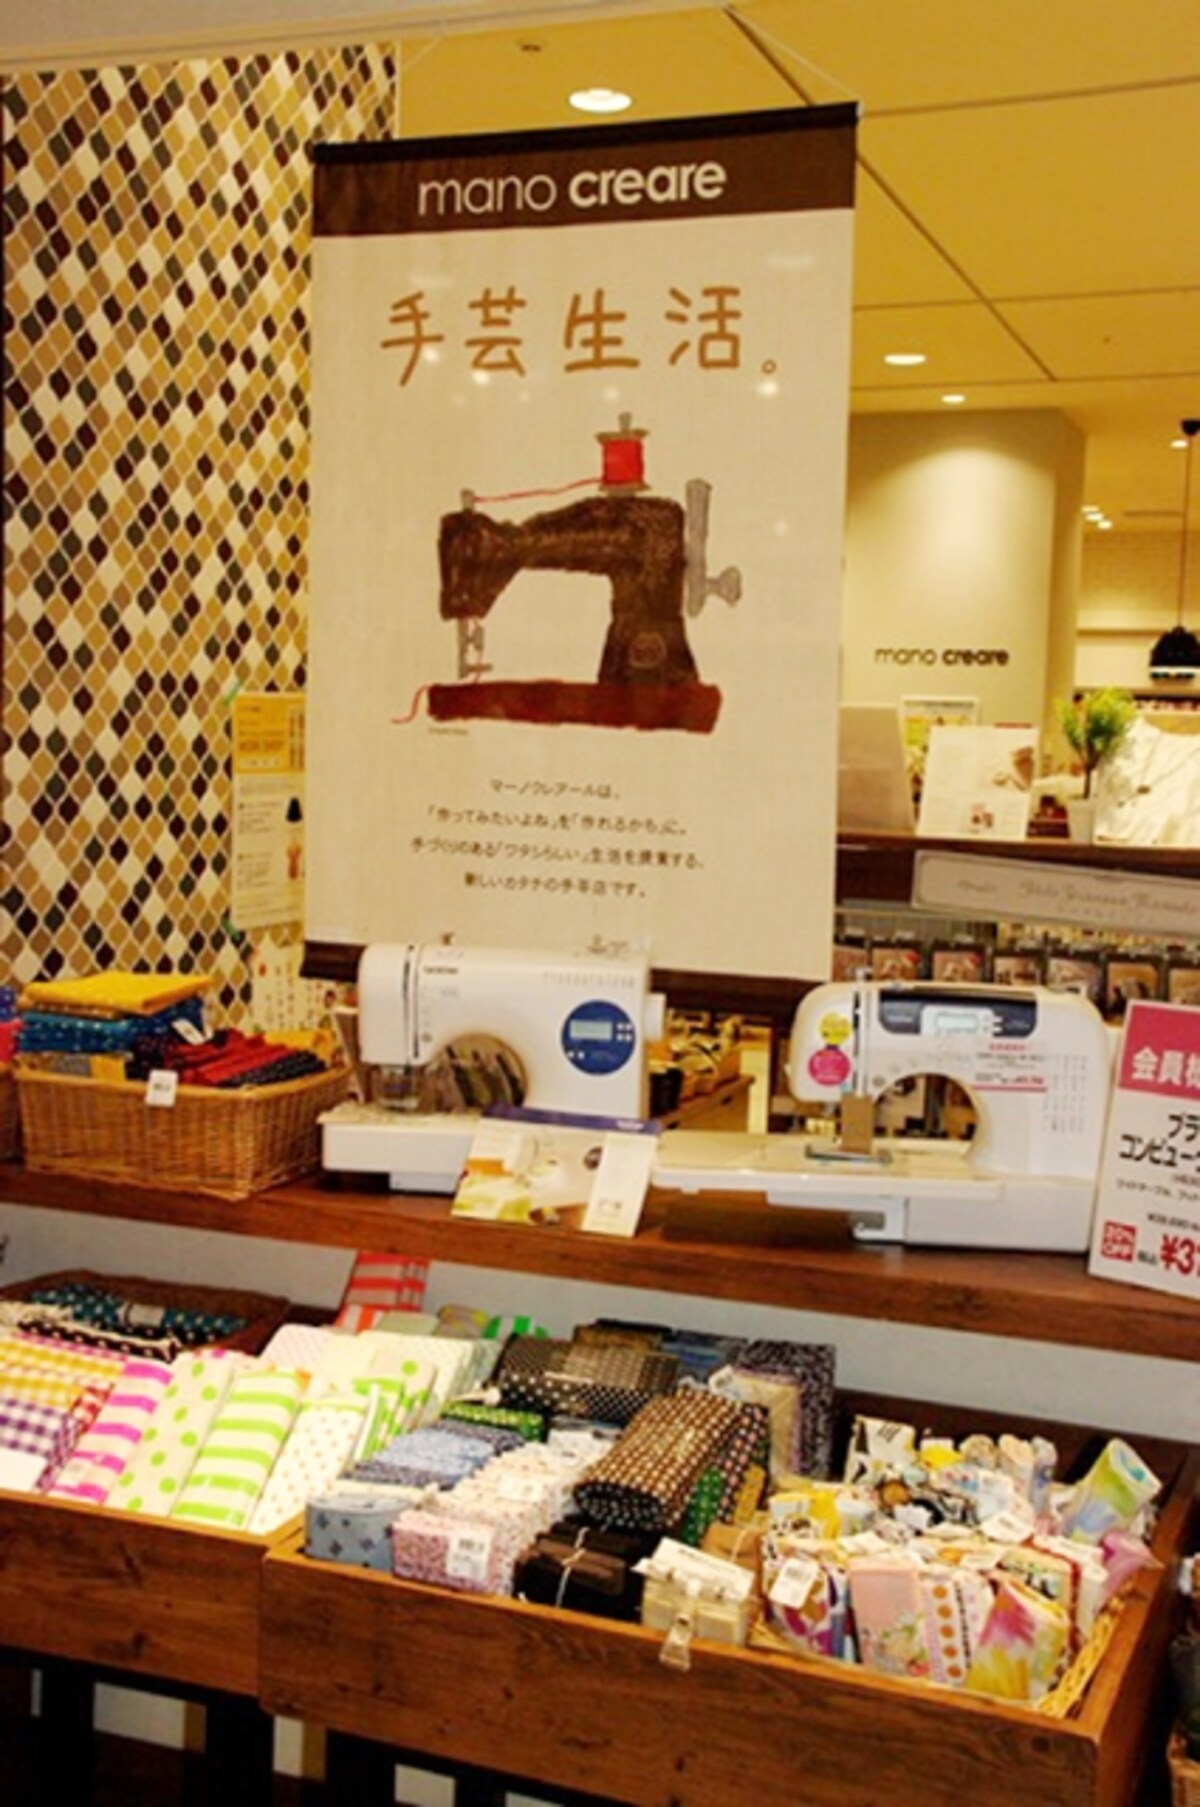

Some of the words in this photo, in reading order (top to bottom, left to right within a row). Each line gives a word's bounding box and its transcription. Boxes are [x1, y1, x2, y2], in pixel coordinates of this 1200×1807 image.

[418, 174, 557, 217] mano
[568, 160, 727, 208] creare
[380, 285, 777, 387] 手芸生活。
[874, 648, 938, 667] mano
[941, 648, 1010, 667] creare
